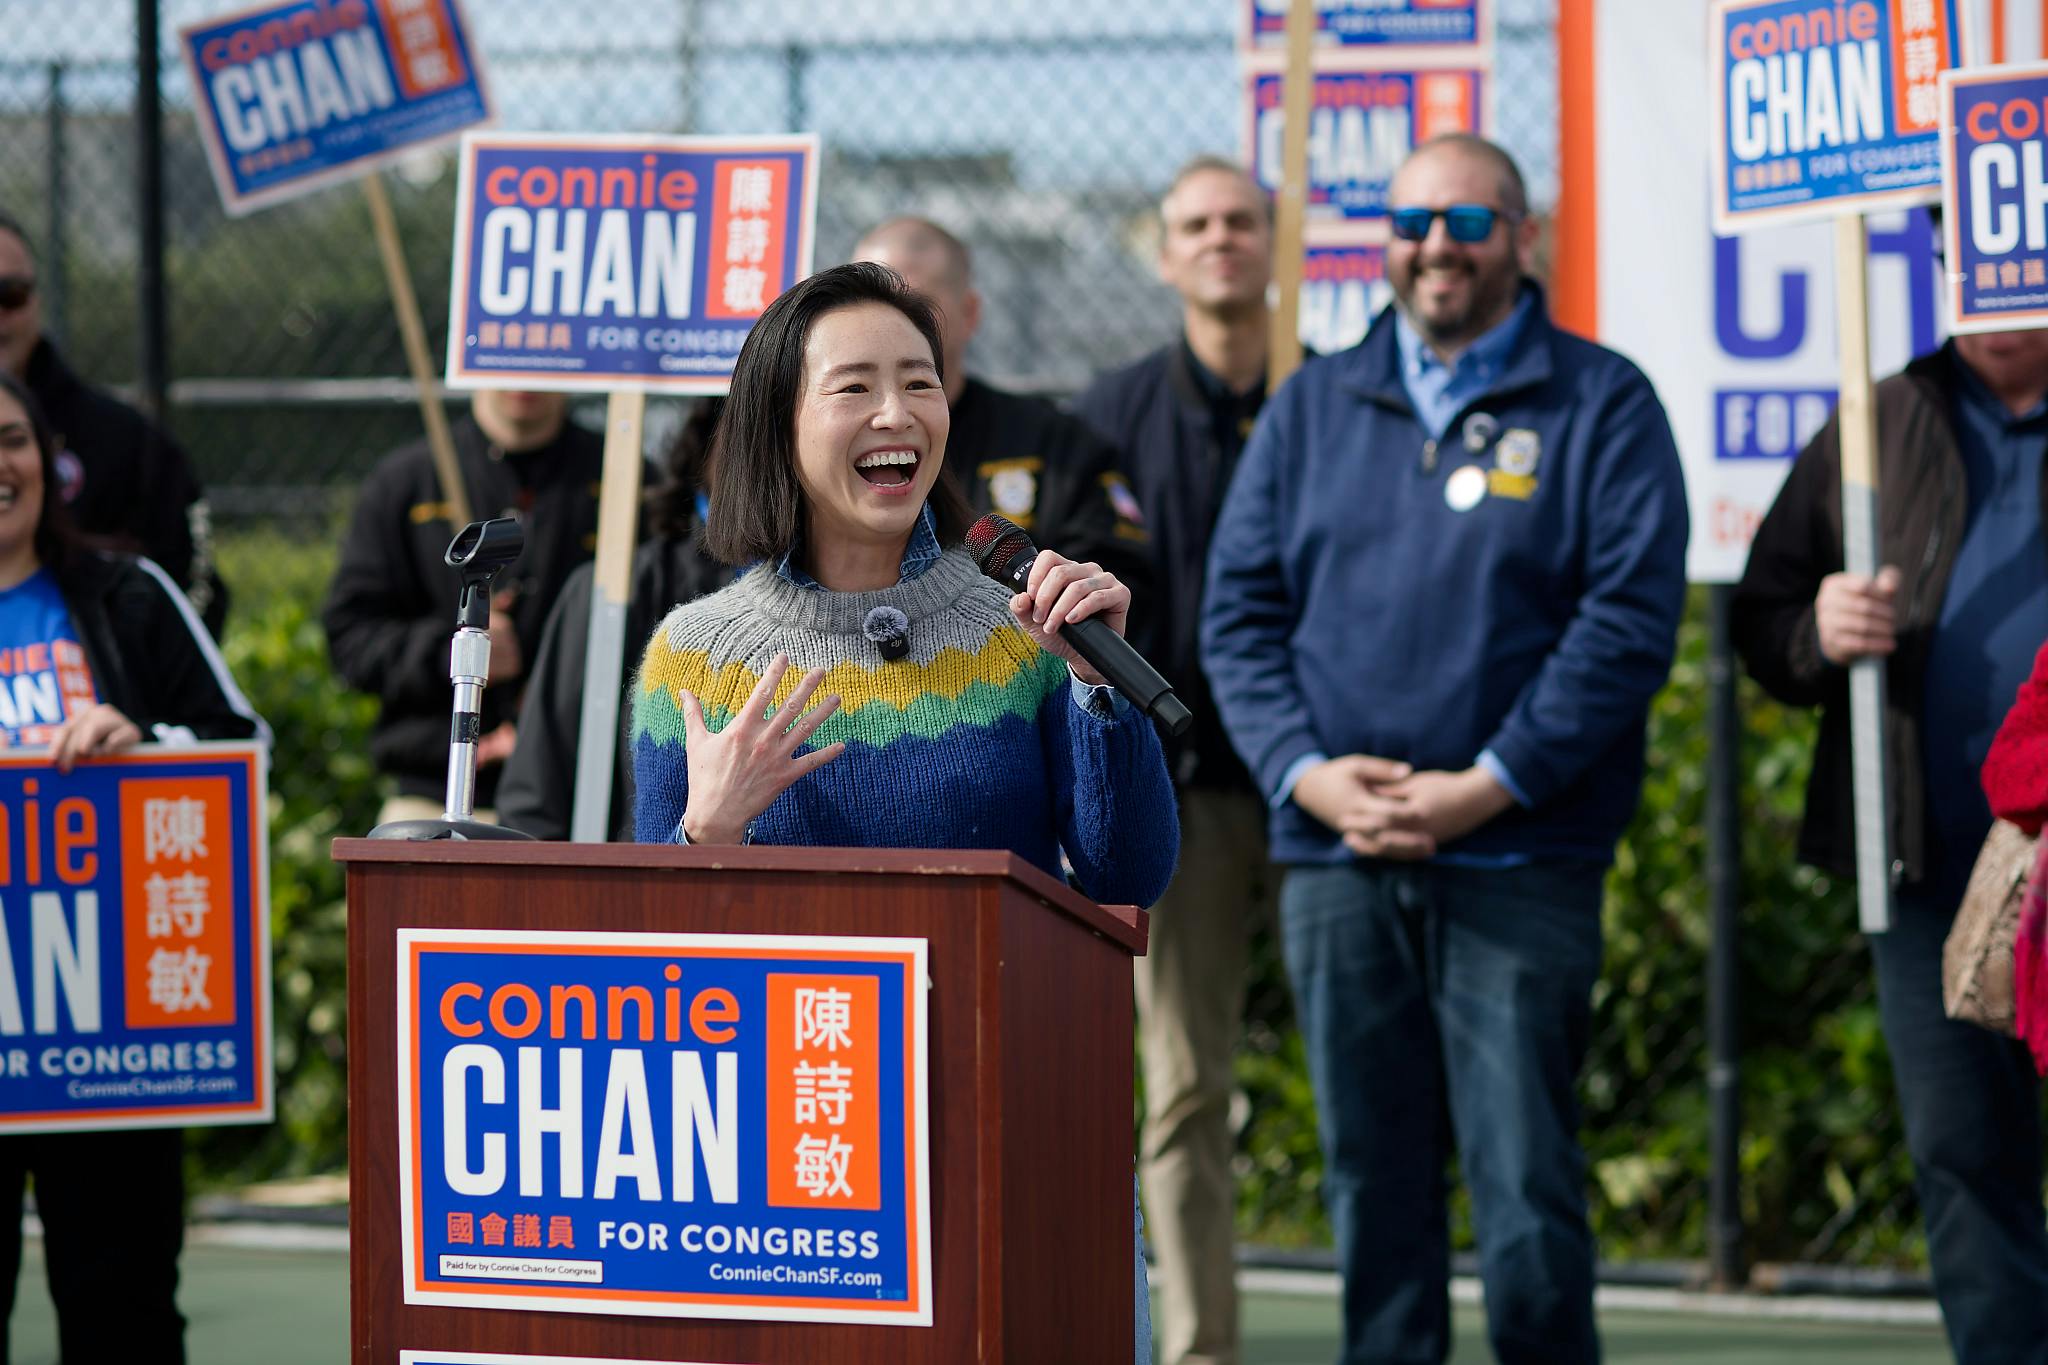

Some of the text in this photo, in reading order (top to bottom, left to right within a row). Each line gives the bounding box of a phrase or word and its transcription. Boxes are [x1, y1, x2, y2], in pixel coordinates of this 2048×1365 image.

[1729, 0, 1878, 60] connie
[211, 24, 396, 153] CHAN
[1730, 38, 1884, 163] CHAN
[1966, 97, 2048, 143] co
[486, 154, 698, 209] connie
[479, 206, 697, 319] CHAN
[587, 326, 640, 351] FOR
[143, 795, 213, 1013] 陳詩敏
[439, 964, 741, 1044] connie
[40, 1039, 237, 1077] CONGRESS
[793, 987, 853, 1199] 陳詩敏
[442, 1044, 738, 1204] CHAN
[447, 1211, 575, 1248] 國會議員
[598, 1221, 880, 1259] FOR CONGRESS
[446, 1261, 597, 1276] Paid for by Connie Chan for Congress
[709, 1263, 882, 1286] ConnieChanSF.com
